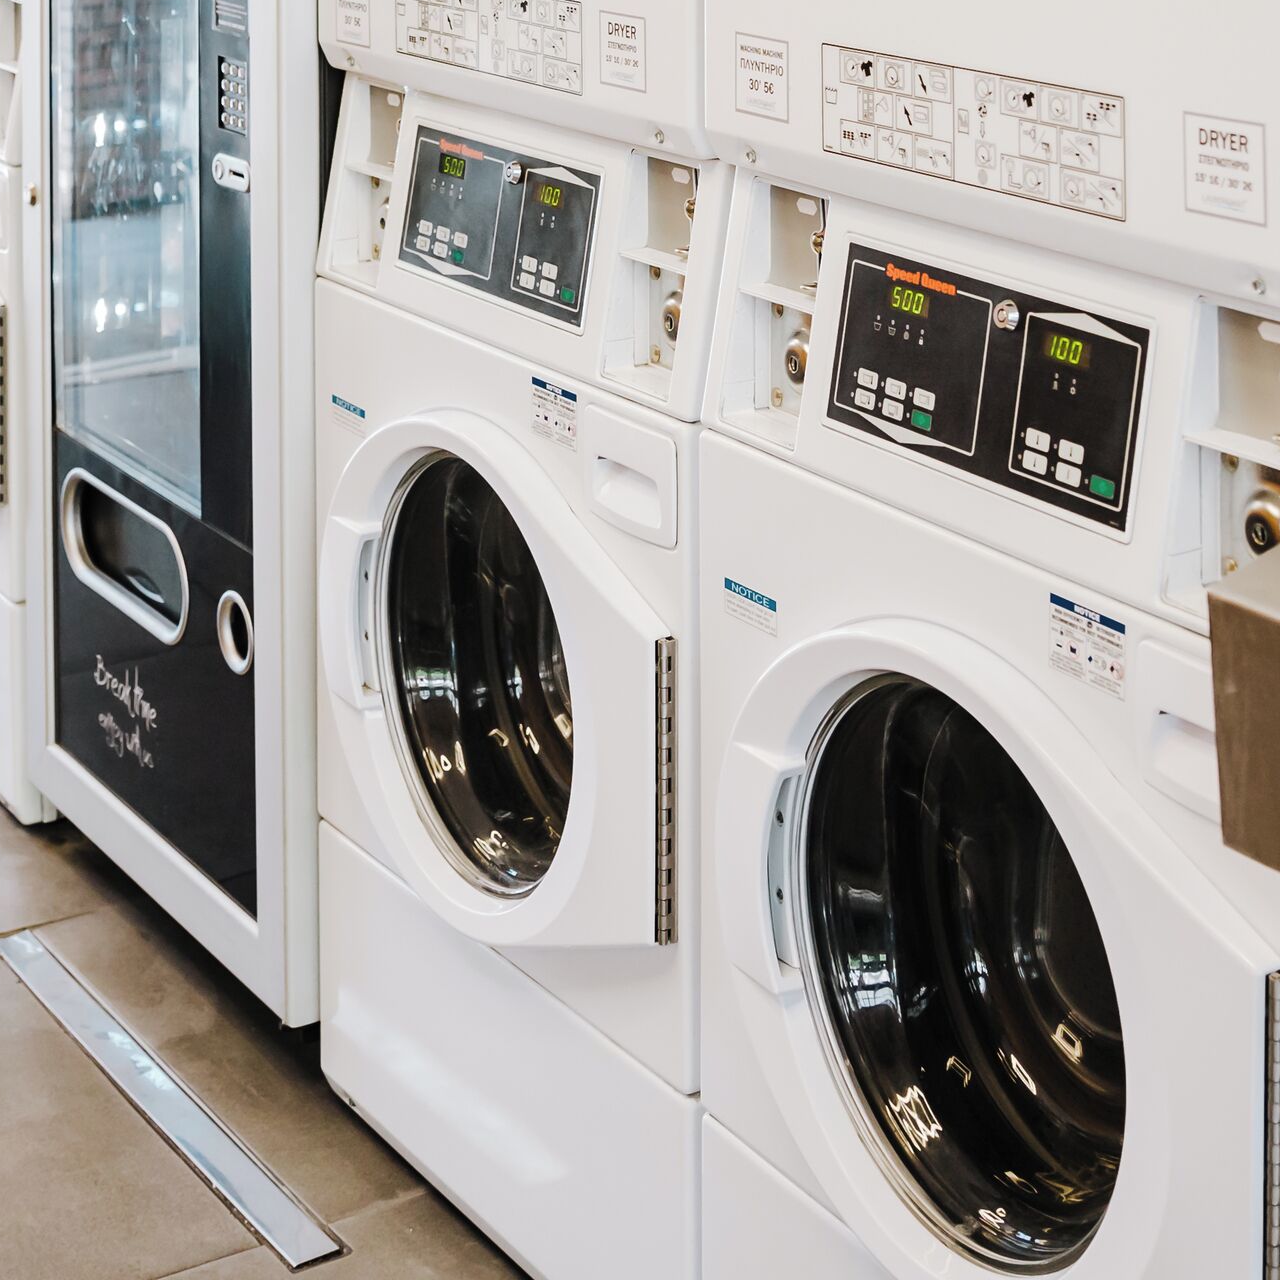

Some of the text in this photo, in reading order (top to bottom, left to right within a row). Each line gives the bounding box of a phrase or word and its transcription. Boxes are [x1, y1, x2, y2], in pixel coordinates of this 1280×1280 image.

[607, 21, 637, 40] DRYER
[740, 57, 784, 77] ΠΛΥΝΤΗΡΙΟ
[764, 81, 774, 94] 5€
[1198, 127, 1248, 154] DRYER
[444, 156, 466, 177] 500
[541, 184, 561, 206] 100
[886, 262, 957, 296] Speed Queen
[892, 286, 925, 315] 500
[1049, 335, 1083, 365] 100
[336, 396, 362, 416] NOTICE
[731, 582, 770, 608] NOTICE
